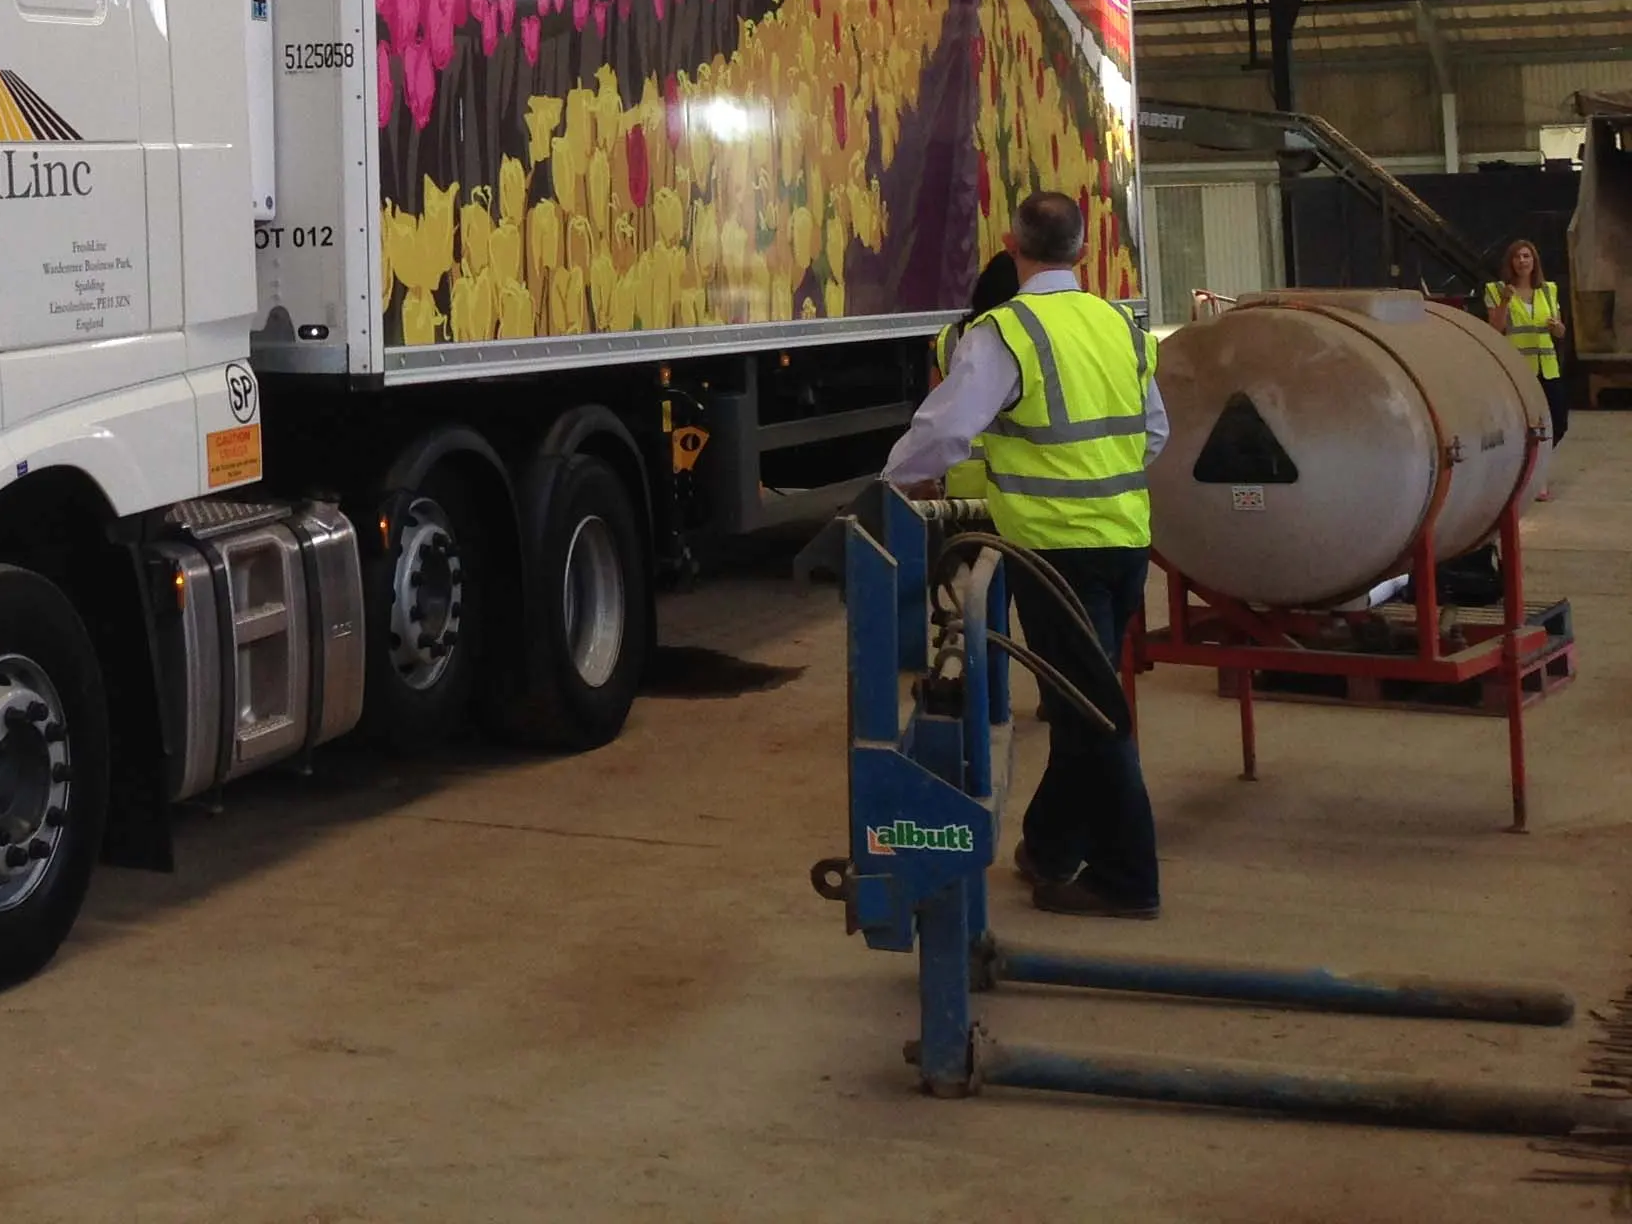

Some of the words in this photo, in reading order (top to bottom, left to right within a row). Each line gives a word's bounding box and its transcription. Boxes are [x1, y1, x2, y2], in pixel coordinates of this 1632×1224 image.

[285, 42, 354, 70] 5125058
[292, 225, 334, 248] 012
[75, 317, 105, 333] England
[230, 375, 253, 411] SP
[876, 820, 974, 852] albutt
